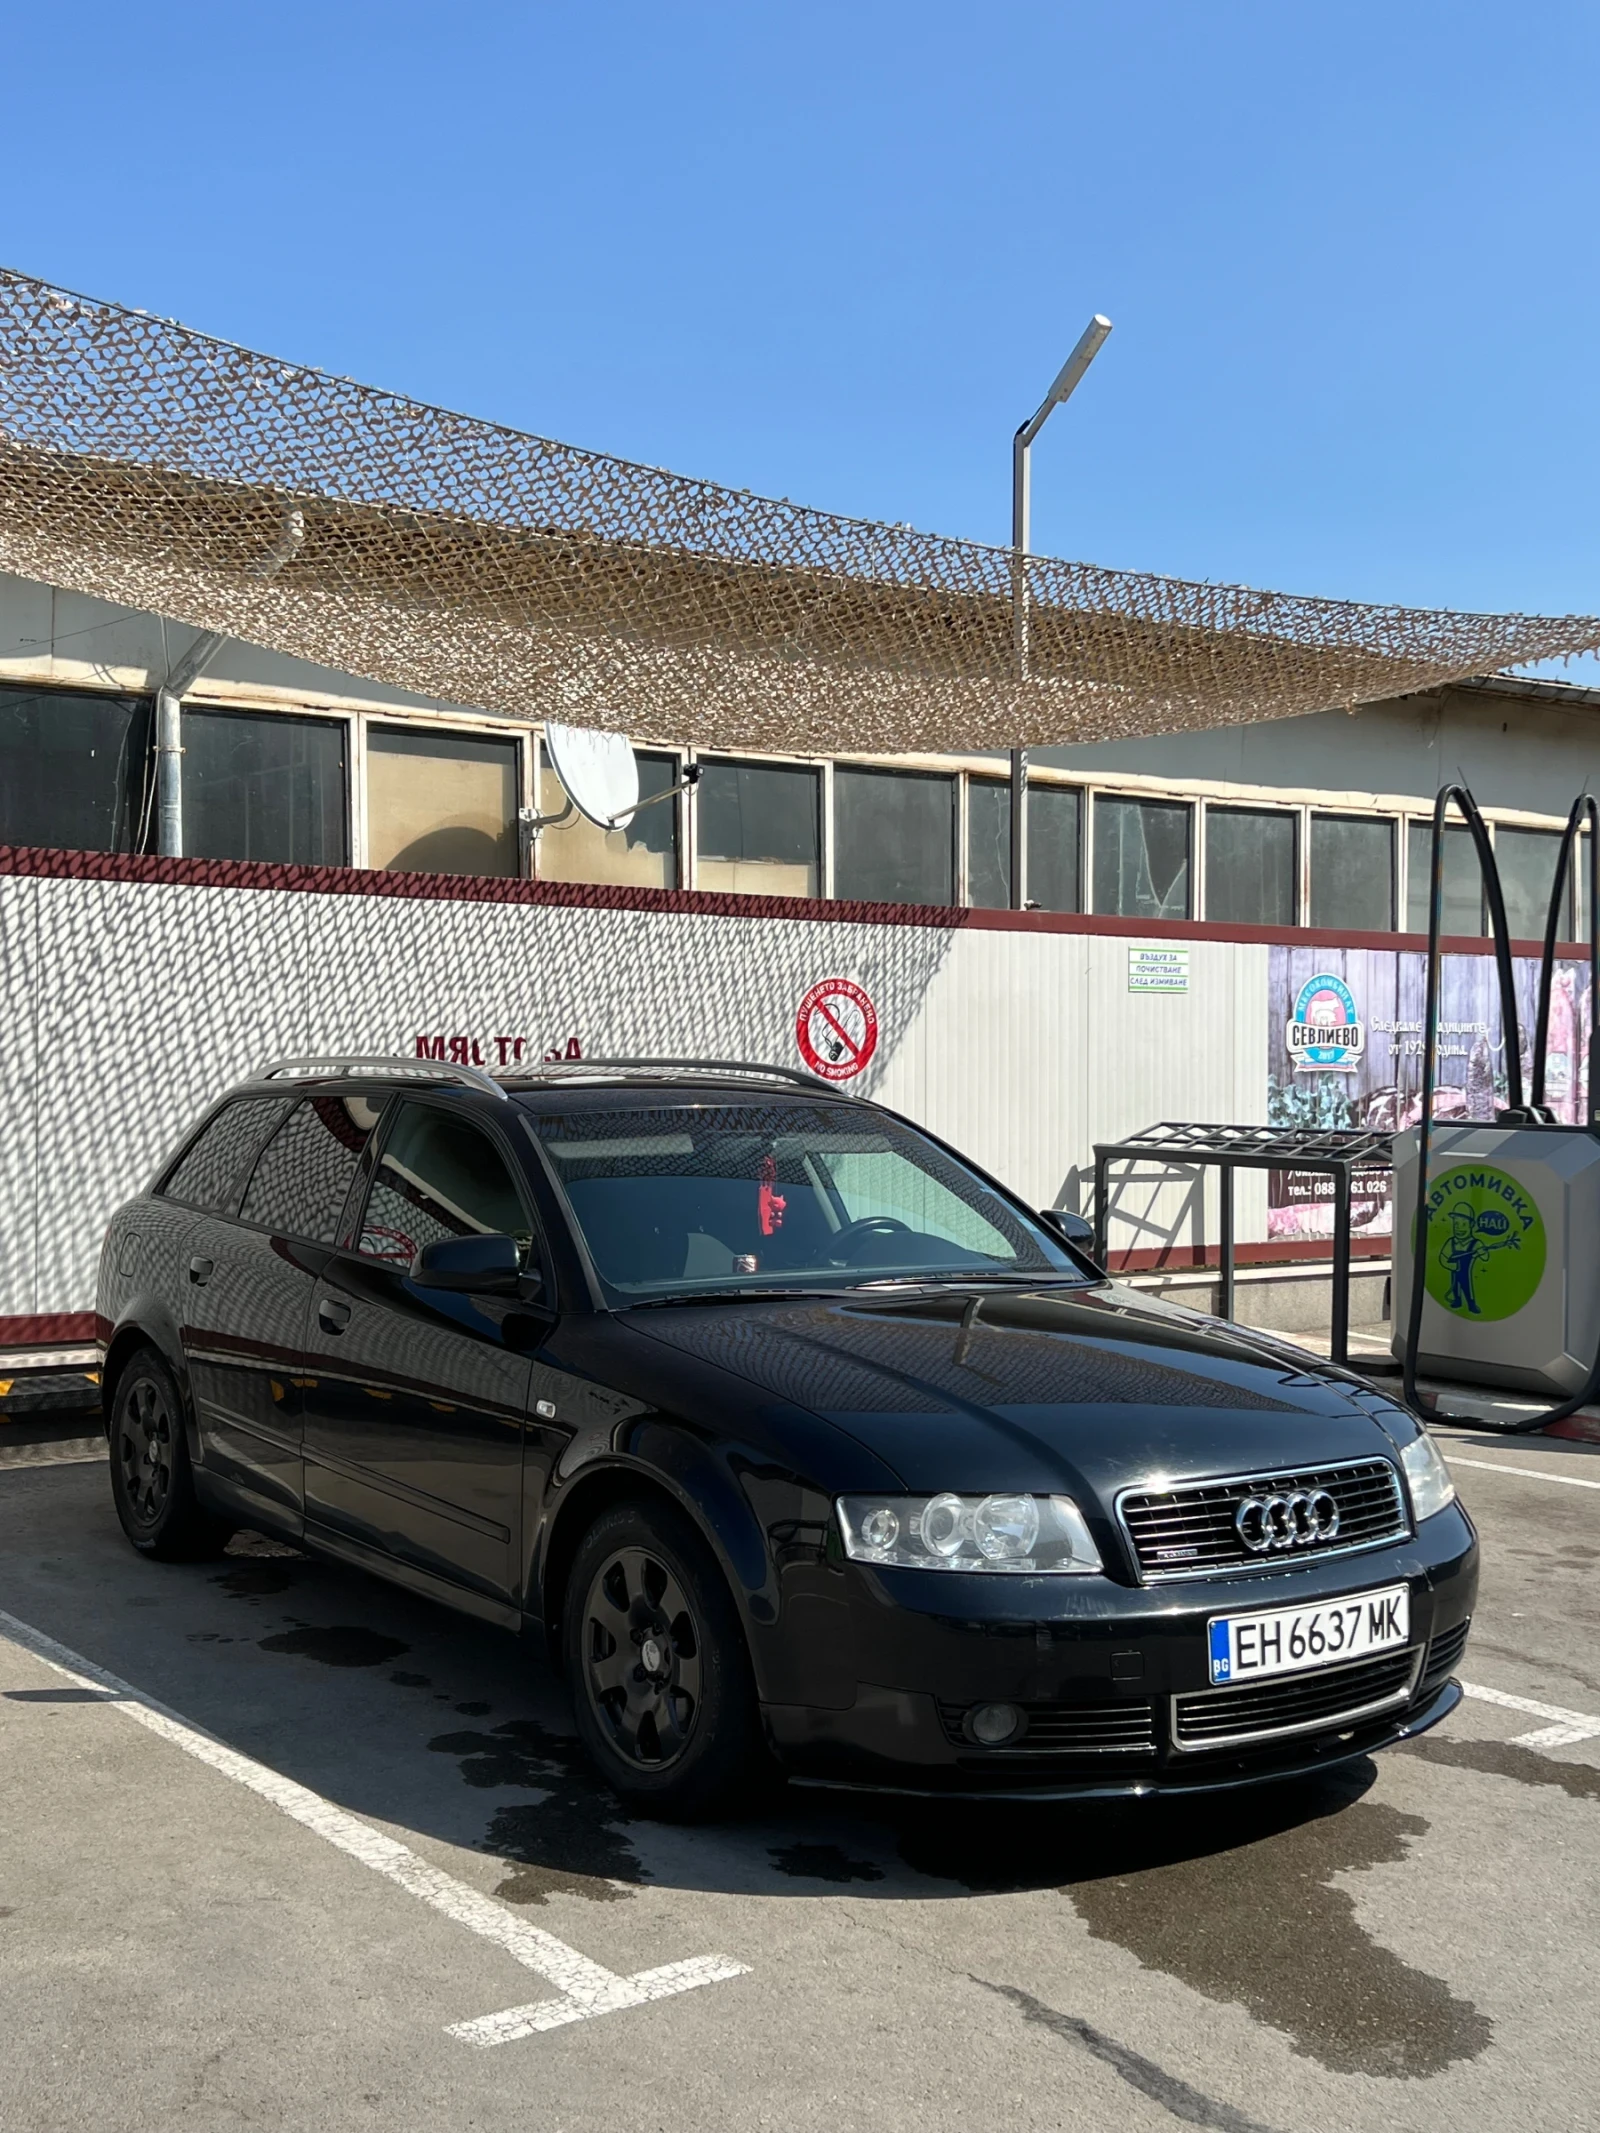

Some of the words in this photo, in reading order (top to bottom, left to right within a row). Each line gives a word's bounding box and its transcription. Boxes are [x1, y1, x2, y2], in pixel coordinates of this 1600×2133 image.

[1136, 965, 1181, 973] ПОЧИСТВАНЕ
[1130, 977, 1148, 985] СЛЕД
[1150, 978, 1187, 986] ИЗМИВАНЕ
[799, 982, 835, 1021] ПУШЕНЕТО
[837, 981, 875, 1025] ЗАБРАНЕНО
[1292, 1025, 1358, 1047] СЕВЛИЕВО
[814, 1060, 826, 1073] NO
[826, 1062, 859, 1077] SMOKING
[1367, 1180, 1387, 1192] 026
[1425, 1173, 1534, 1231] АВТОМИВКА
[1479, 1215, 1507, 1230] НАЙ
[1235, 1620, 1281, 1670] EH
[1289, 1605, 1362, 1660] 6637
[1369, 1595, 1402, 1643] MK
[1213, 1657, 1229, 1674] BG
